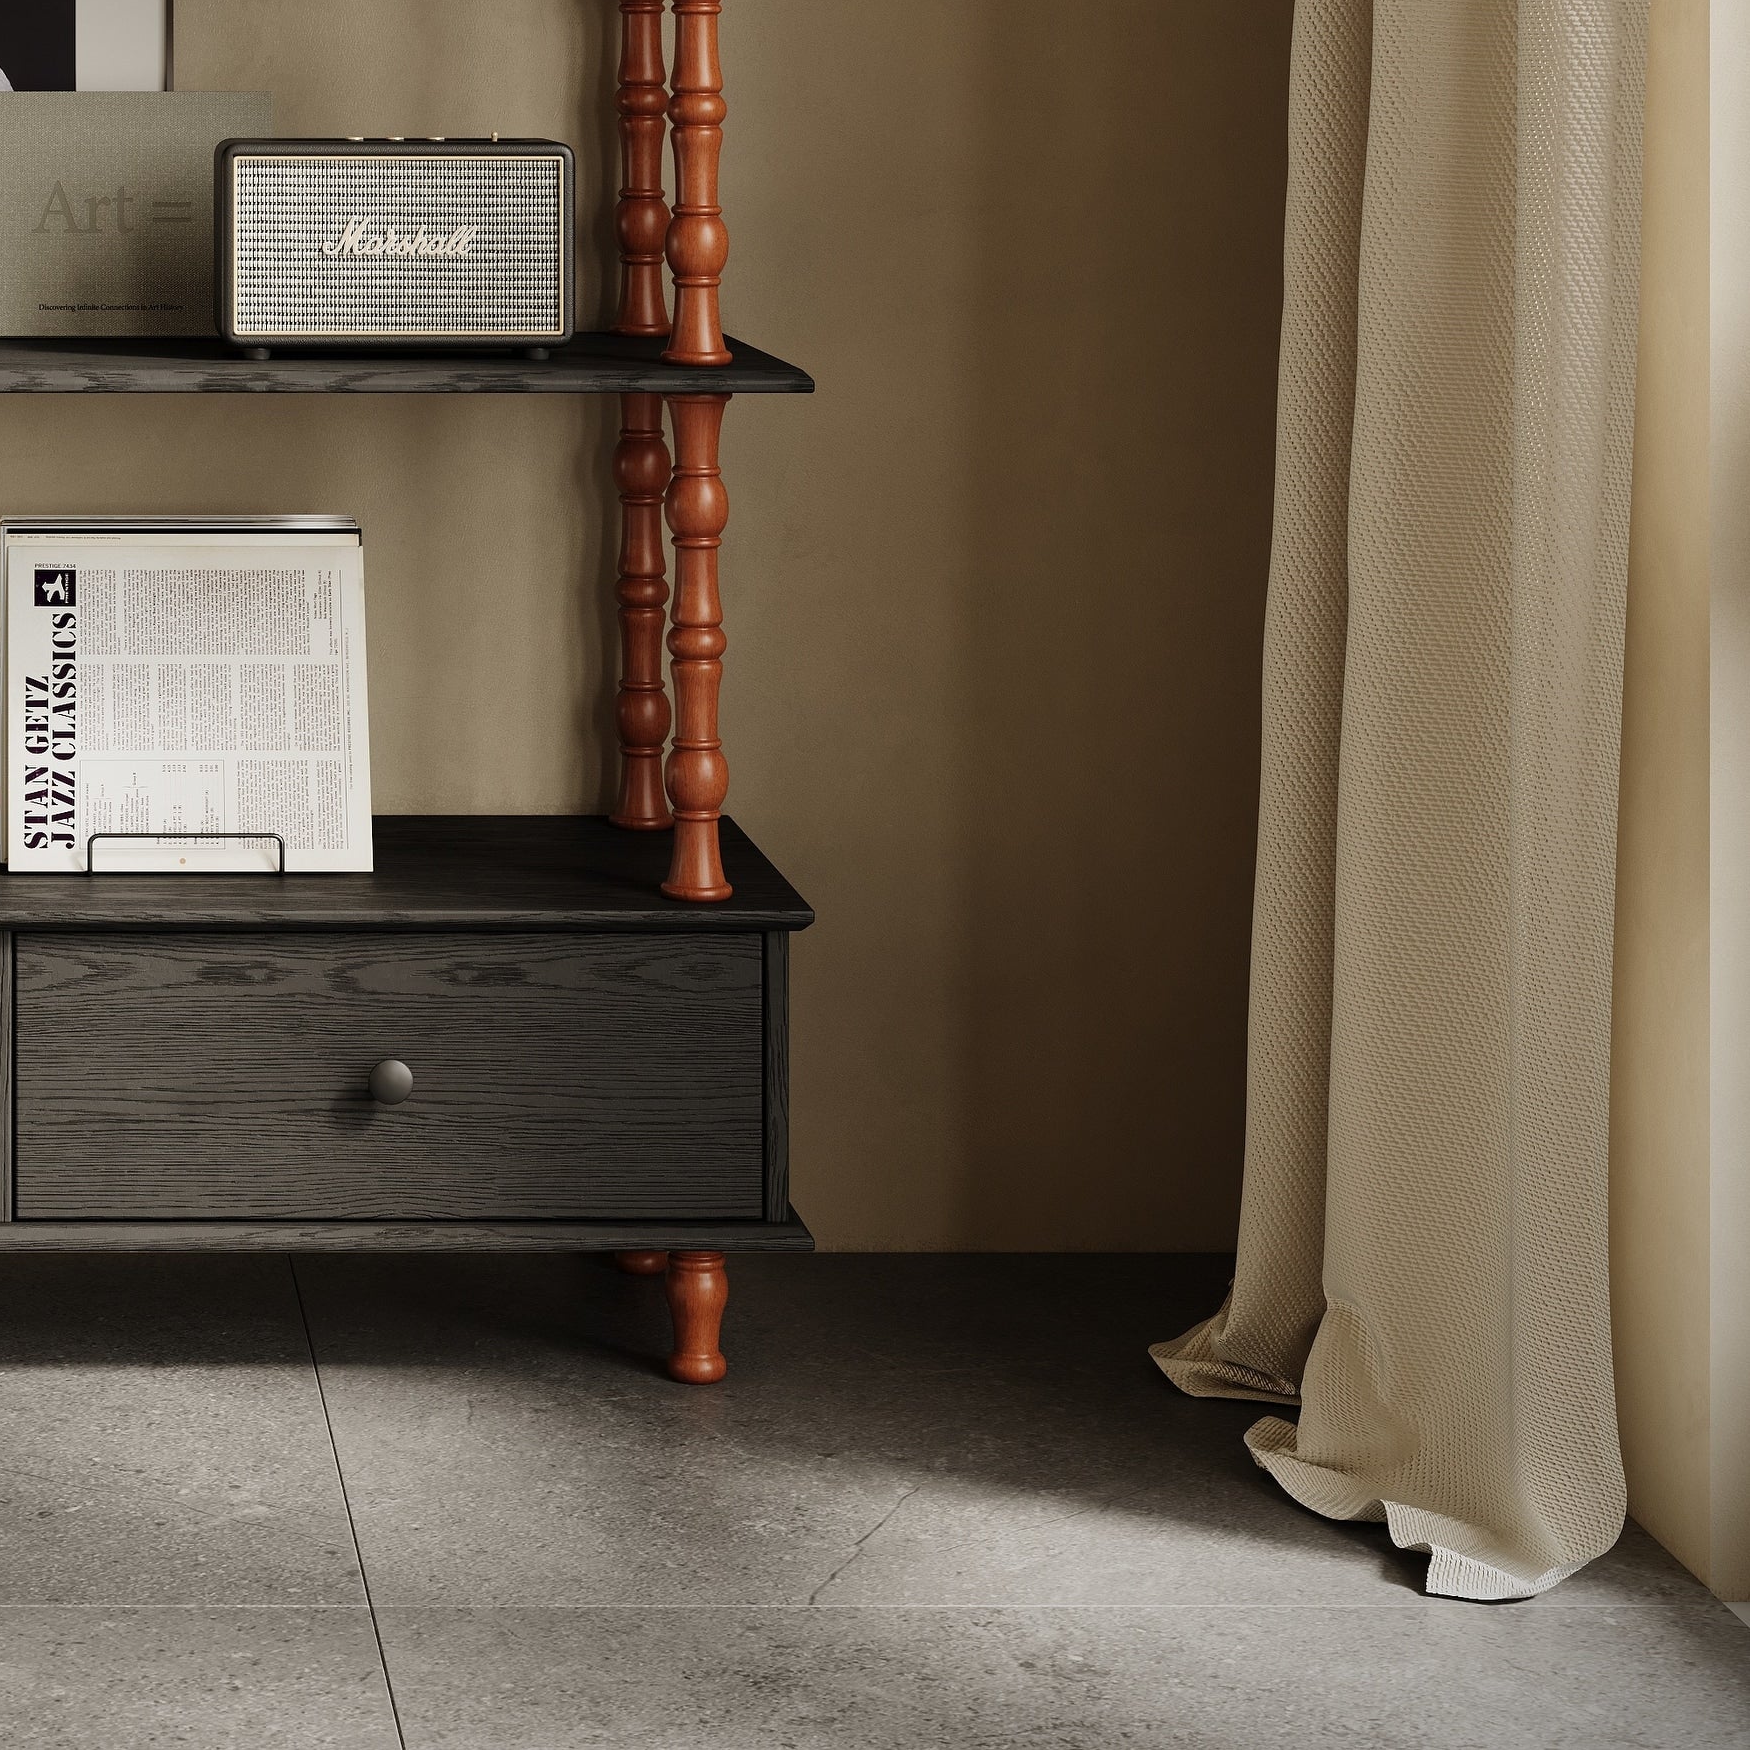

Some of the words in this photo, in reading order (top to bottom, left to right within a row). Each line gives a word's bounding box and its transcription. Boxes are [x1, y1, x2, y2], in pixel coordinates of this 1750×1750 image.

[31, 179, 135, 235] Art
[322, 215, 478, 257] Marshall
[38, 303, 77, 312] Discovering
[25, 675, 49, 755] GETZ
[52, 612, 77, 761] CLASSICS
[24, 764, 49, 850] STAN
[51, 770, 76, 850] JAZZ
